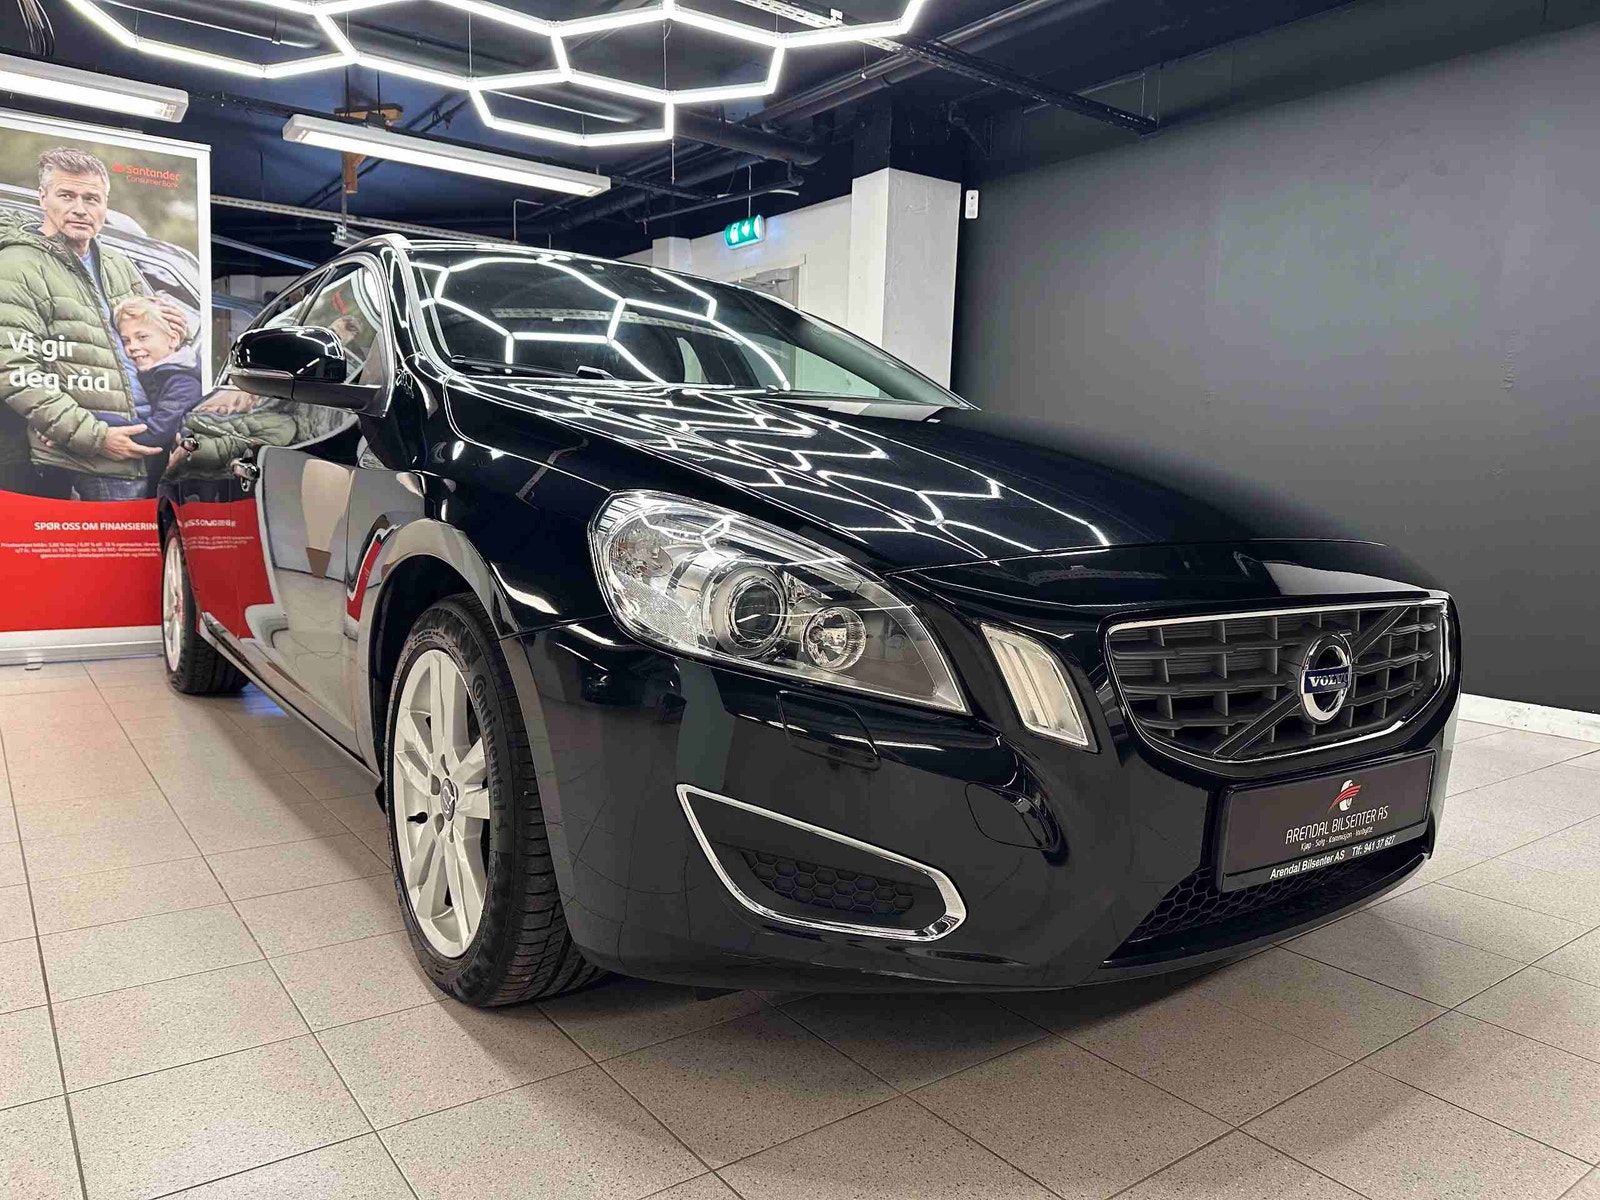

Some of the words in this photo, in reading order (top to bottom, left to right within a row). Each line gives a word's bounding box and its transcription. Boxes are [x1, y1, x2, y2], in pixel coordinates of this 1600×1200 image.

[126, 165, 181, 180] Santander
[7, 331, 38, 356] Vi
[41, 335, 78, 361] gir
[9, 365, 60, 395] deg
[67, 368, 110, 392] råd
[33, 521, 61, 531] SPØR
[61, 522, 81, 531] OSS
[81, 522, 98, 531] OM
[99, 522, 159, 531] FINANSIERIN
[1285, 821, 1329, 845] ARENDAL
[1331, 808, 1377, 833] BILSENTER
[1377, 805, 1390, 820] AS
[1269, 861, 1301, 880] Arendal
[1301, 854, 1334, 871] Bilsenter
[1333, 849, 1346, 862] AS
[1352, 844, 1362, 857] Tlf:
[1363, 841, 1376, 853] 941
[1375, 838, 1385, 849] 37
[1384, 834, 1396, 847] 627
